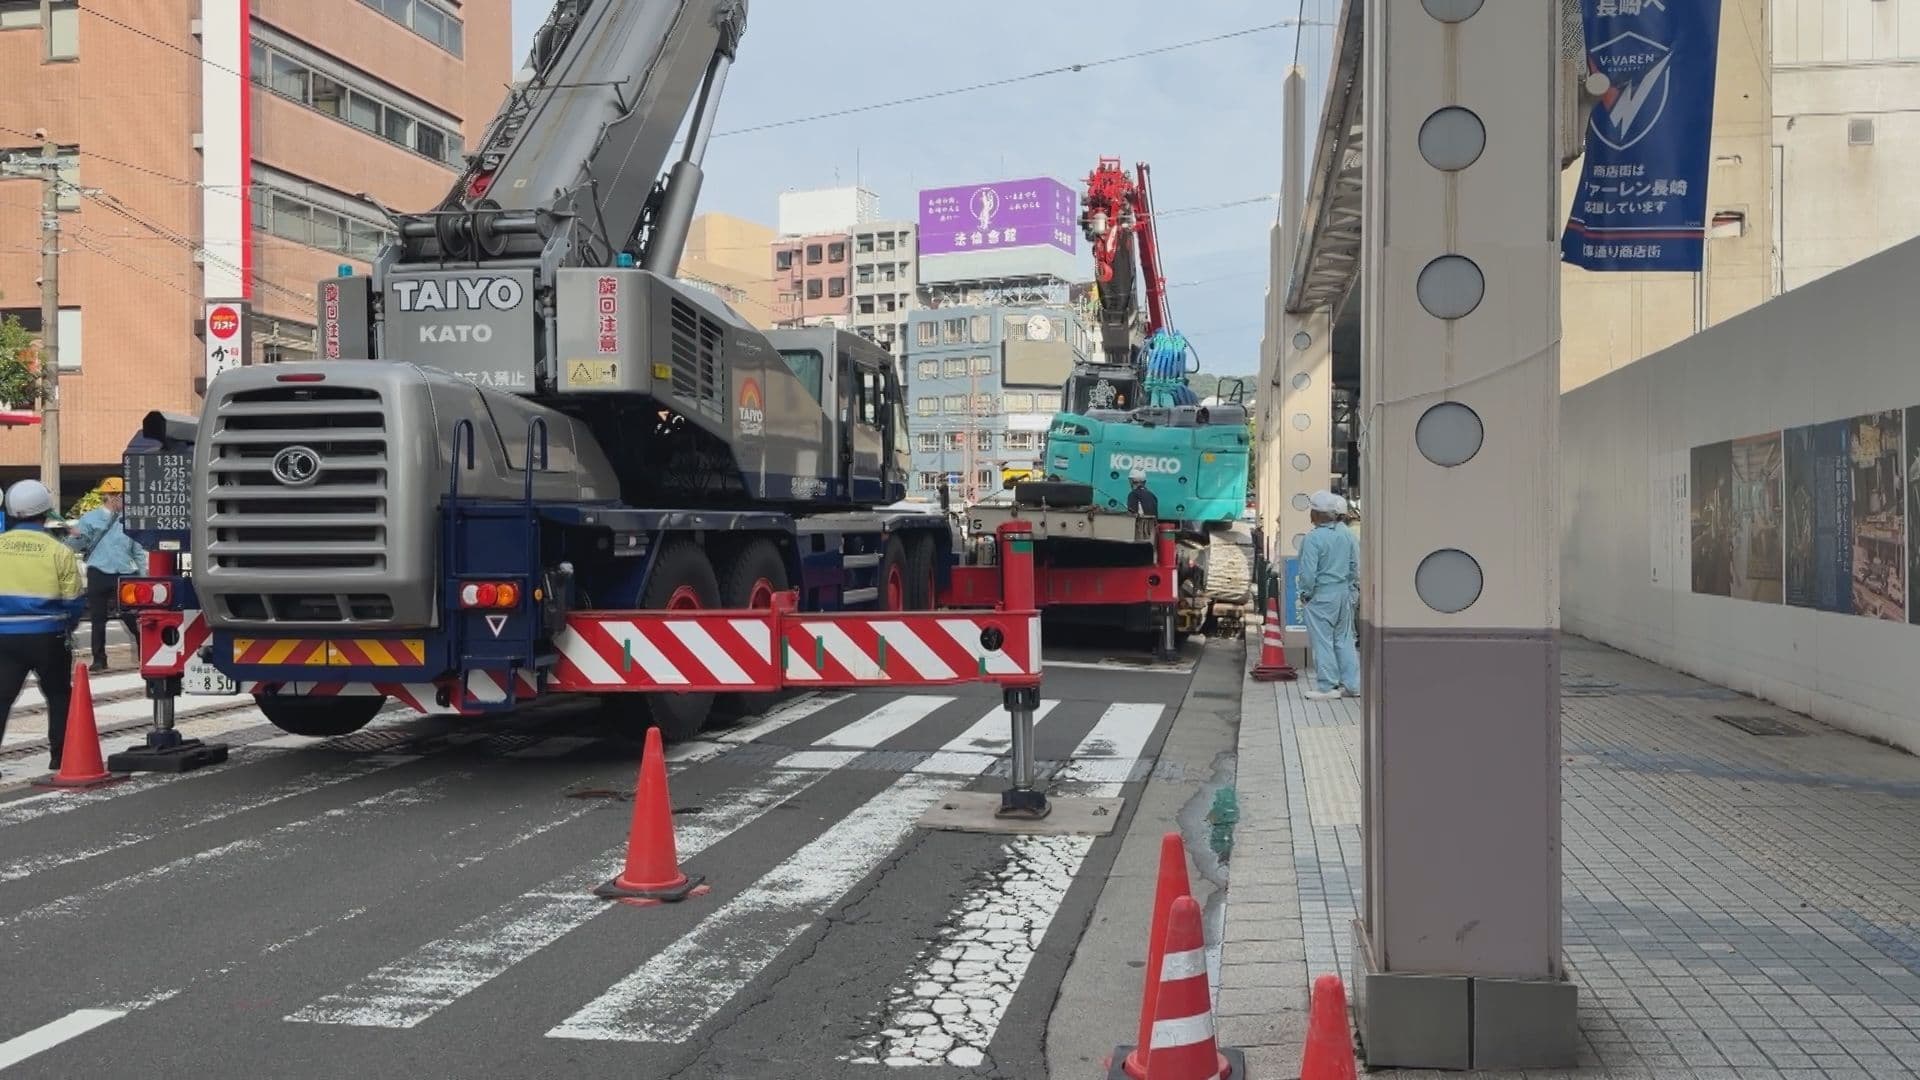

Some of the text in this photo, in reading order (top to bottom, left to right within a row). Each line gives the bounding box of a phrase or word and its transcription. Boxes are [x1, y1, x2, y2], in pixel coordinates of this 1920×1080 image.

[1600, 54, 1654, 66] V-VAREN
[1584, 179, 1688, 197] ァーレン長崎
[392, 278, 523, 311] TAIYO
[597, 276, 618, 353] 旋回注意
[419, 324, 492, 342] KATO
[1110, 453, 1181, 474] KOBELCO
[163, 467, 186, 480] 285
[150, 505, 186, 517] 20800
[157, 518, 186, 530] 5285
